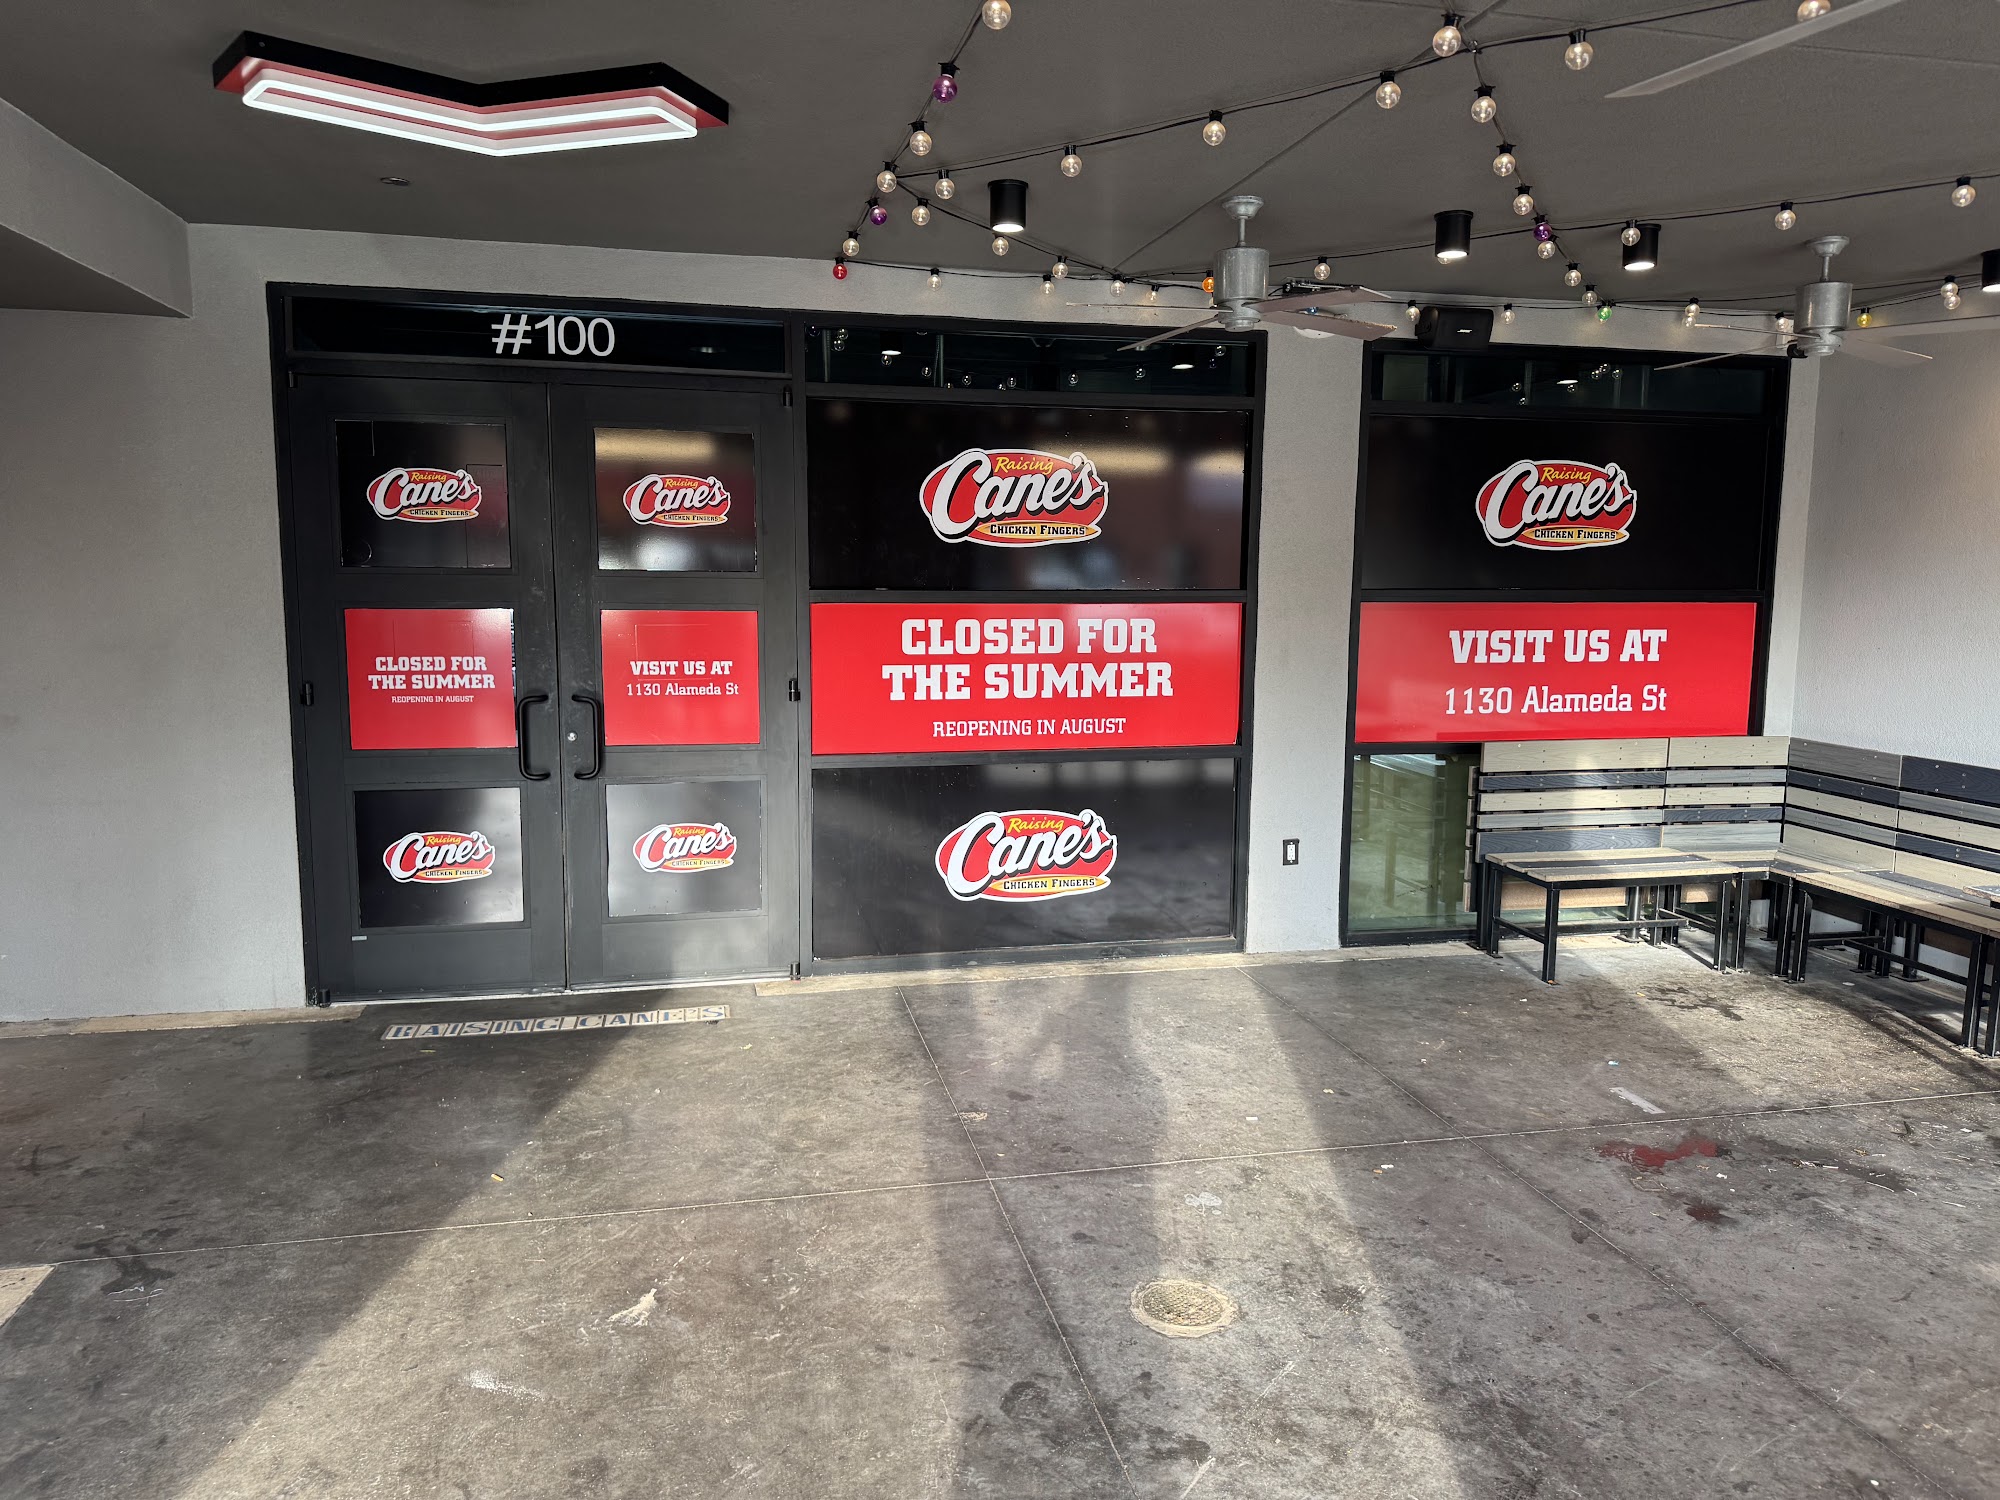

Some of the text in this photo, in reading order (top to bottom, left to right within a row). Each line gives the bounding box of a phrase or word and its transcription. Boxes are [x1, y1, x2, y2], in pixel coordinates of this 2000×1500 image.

[491, 313, 615, 357] #100
[411, 472, 447, 482] Raising
[994, 456, 1054, 475] Raising
[1540, 467, 1592, 484] Raising
[374, 469, 478, 516] Cane's
[664, 478, 700, 489] Raising
[931, 451, 1104, 535] Cane's
[630, 475, 728, 521] Cane's
[1485, 461, 1633, 540] Cane's
[901, 618, 1157, 656] CLOSED FOR
[1449, 628, 1668, 664] VISIT US AT
[375, 656, 487, 672] CLOSED FOR
[629, 660, 733, 675] VISIT US AT
[367, 674, 496, 690] THE SUMMER
[626, 682, 739, 696] 1130 Alameda St
[881, 661, 1174, 701] THE SUMMER
[391, 695, 474, 704] REOPENING IN AUGUST
[1444, 684, 1667, 715] 1130 Alameda St
[932, 717, 1127, 738] REOPENING IN AUGUST
[673, 826, 706, 837] Raising
[1006, 816, 1065, 833] Raising
[425, 835, 462, 846] Raising
[639, 823, 734, 869] Cane's
[946, 812, 1113, 894] Cane's
[390, 832, 492, 879] Cane's
[391, 1006, 725, 1038] RAISING CANE'S
